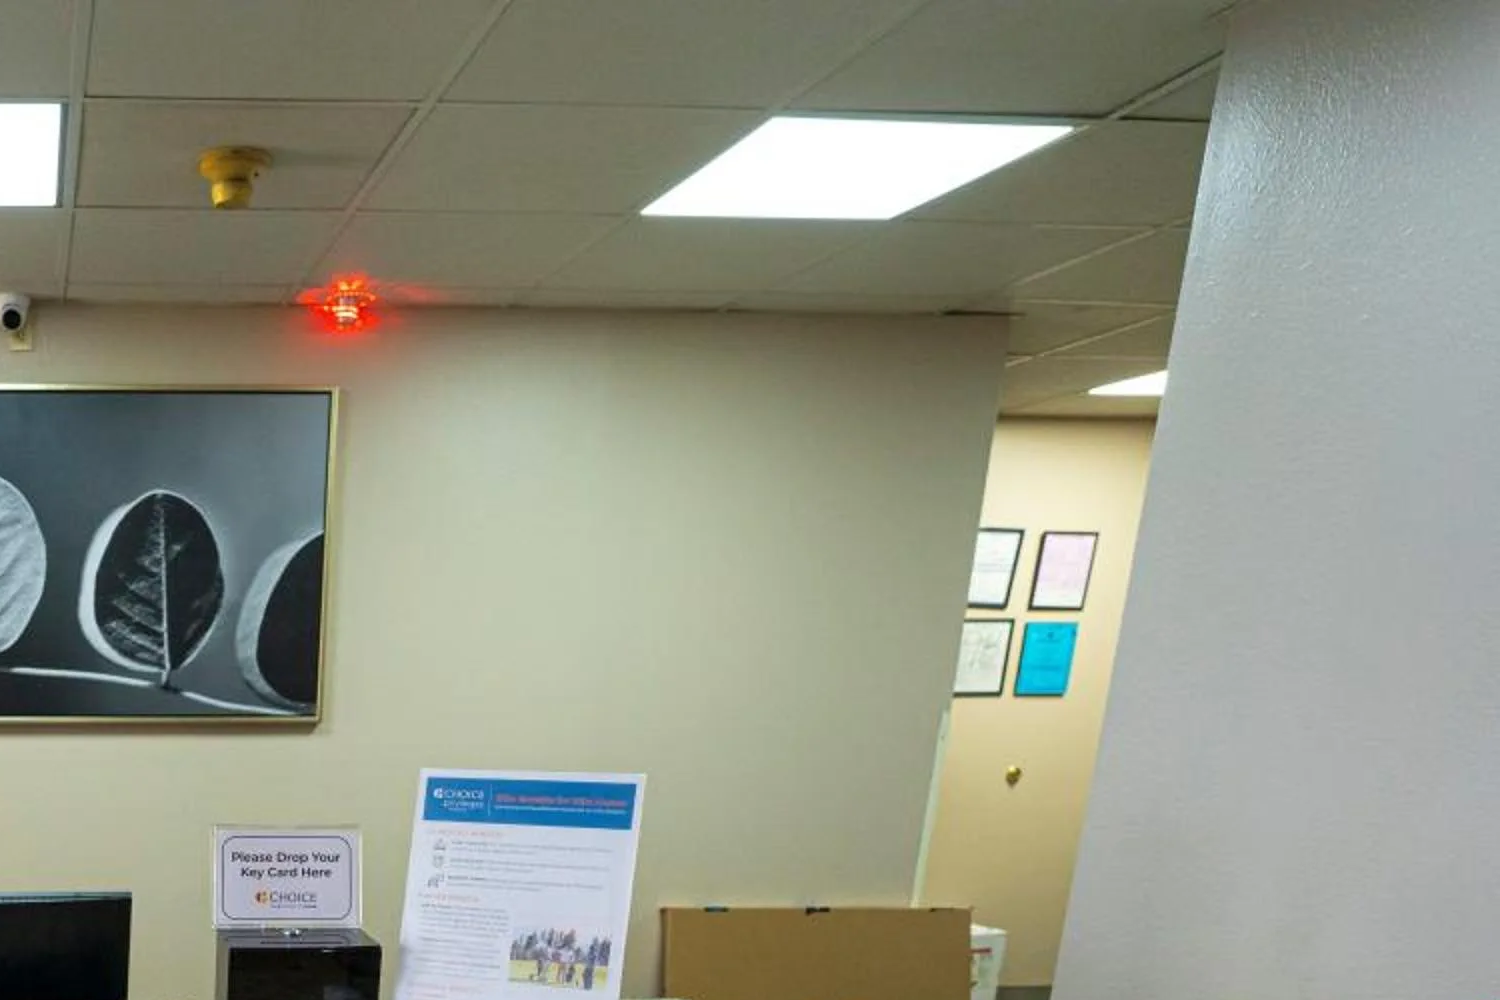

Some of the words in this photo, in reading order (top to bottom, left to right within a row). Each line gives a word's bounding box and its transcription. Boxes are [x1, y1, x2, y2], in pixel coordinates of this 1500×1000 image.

[231, 851, 273, 862] Please
[277, 851, 309, 864] Drop
[312, 851, 340, 862] Your
[241, 867, 264, 880] Key
[268, 867, 297, 877] Card
[301, 867, 332, 877] Here
[270, 891, 317, 902] CHOICE
